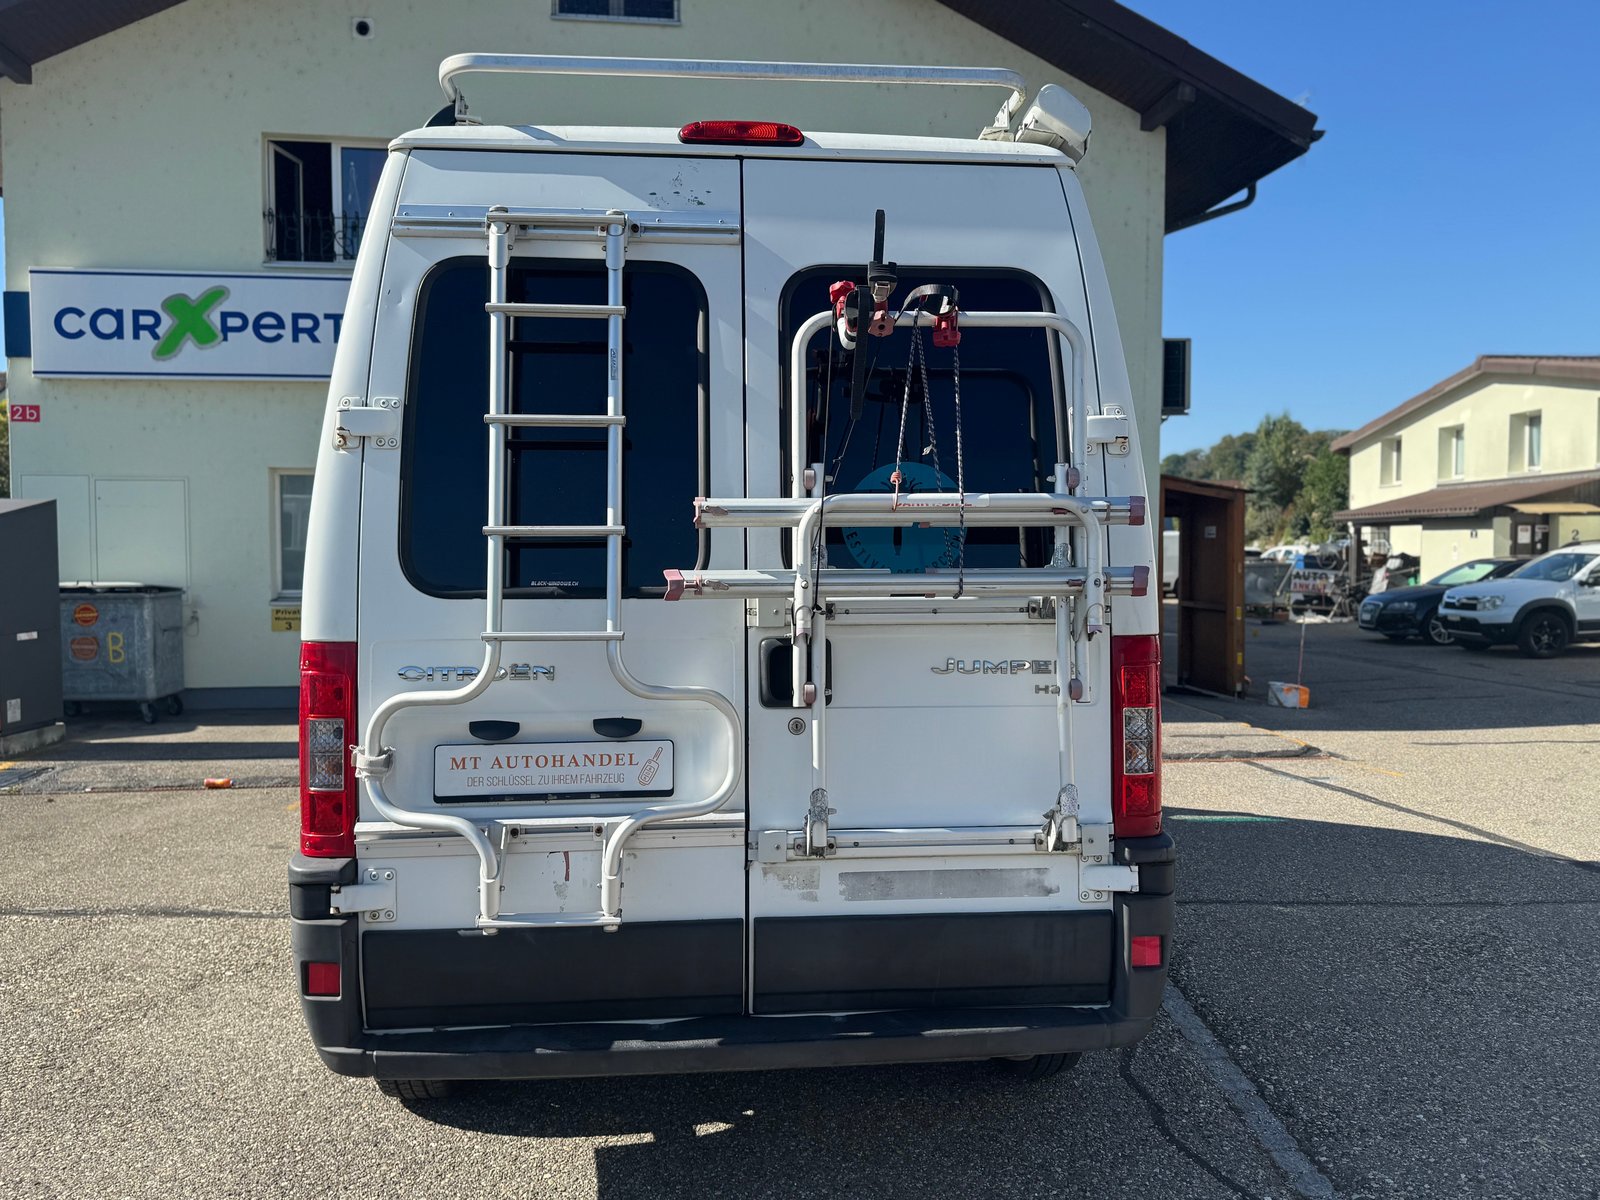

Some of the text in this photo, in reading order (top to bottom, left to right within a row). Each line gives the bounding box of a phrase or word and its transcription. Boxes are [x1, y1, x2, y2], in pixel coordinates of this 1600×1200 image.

[12, 405, 38, 420] 2b
[1571, 529, 1580, 541] 2
[285, 621, 293, 631] 3
[107, 631, 125, 663] B
[449, 752, 640, 770] MT AUTOHANDEL
[466, 772, 625, 787] DER SCHLÜSSEL ZU IHREM FAHRZEUG
